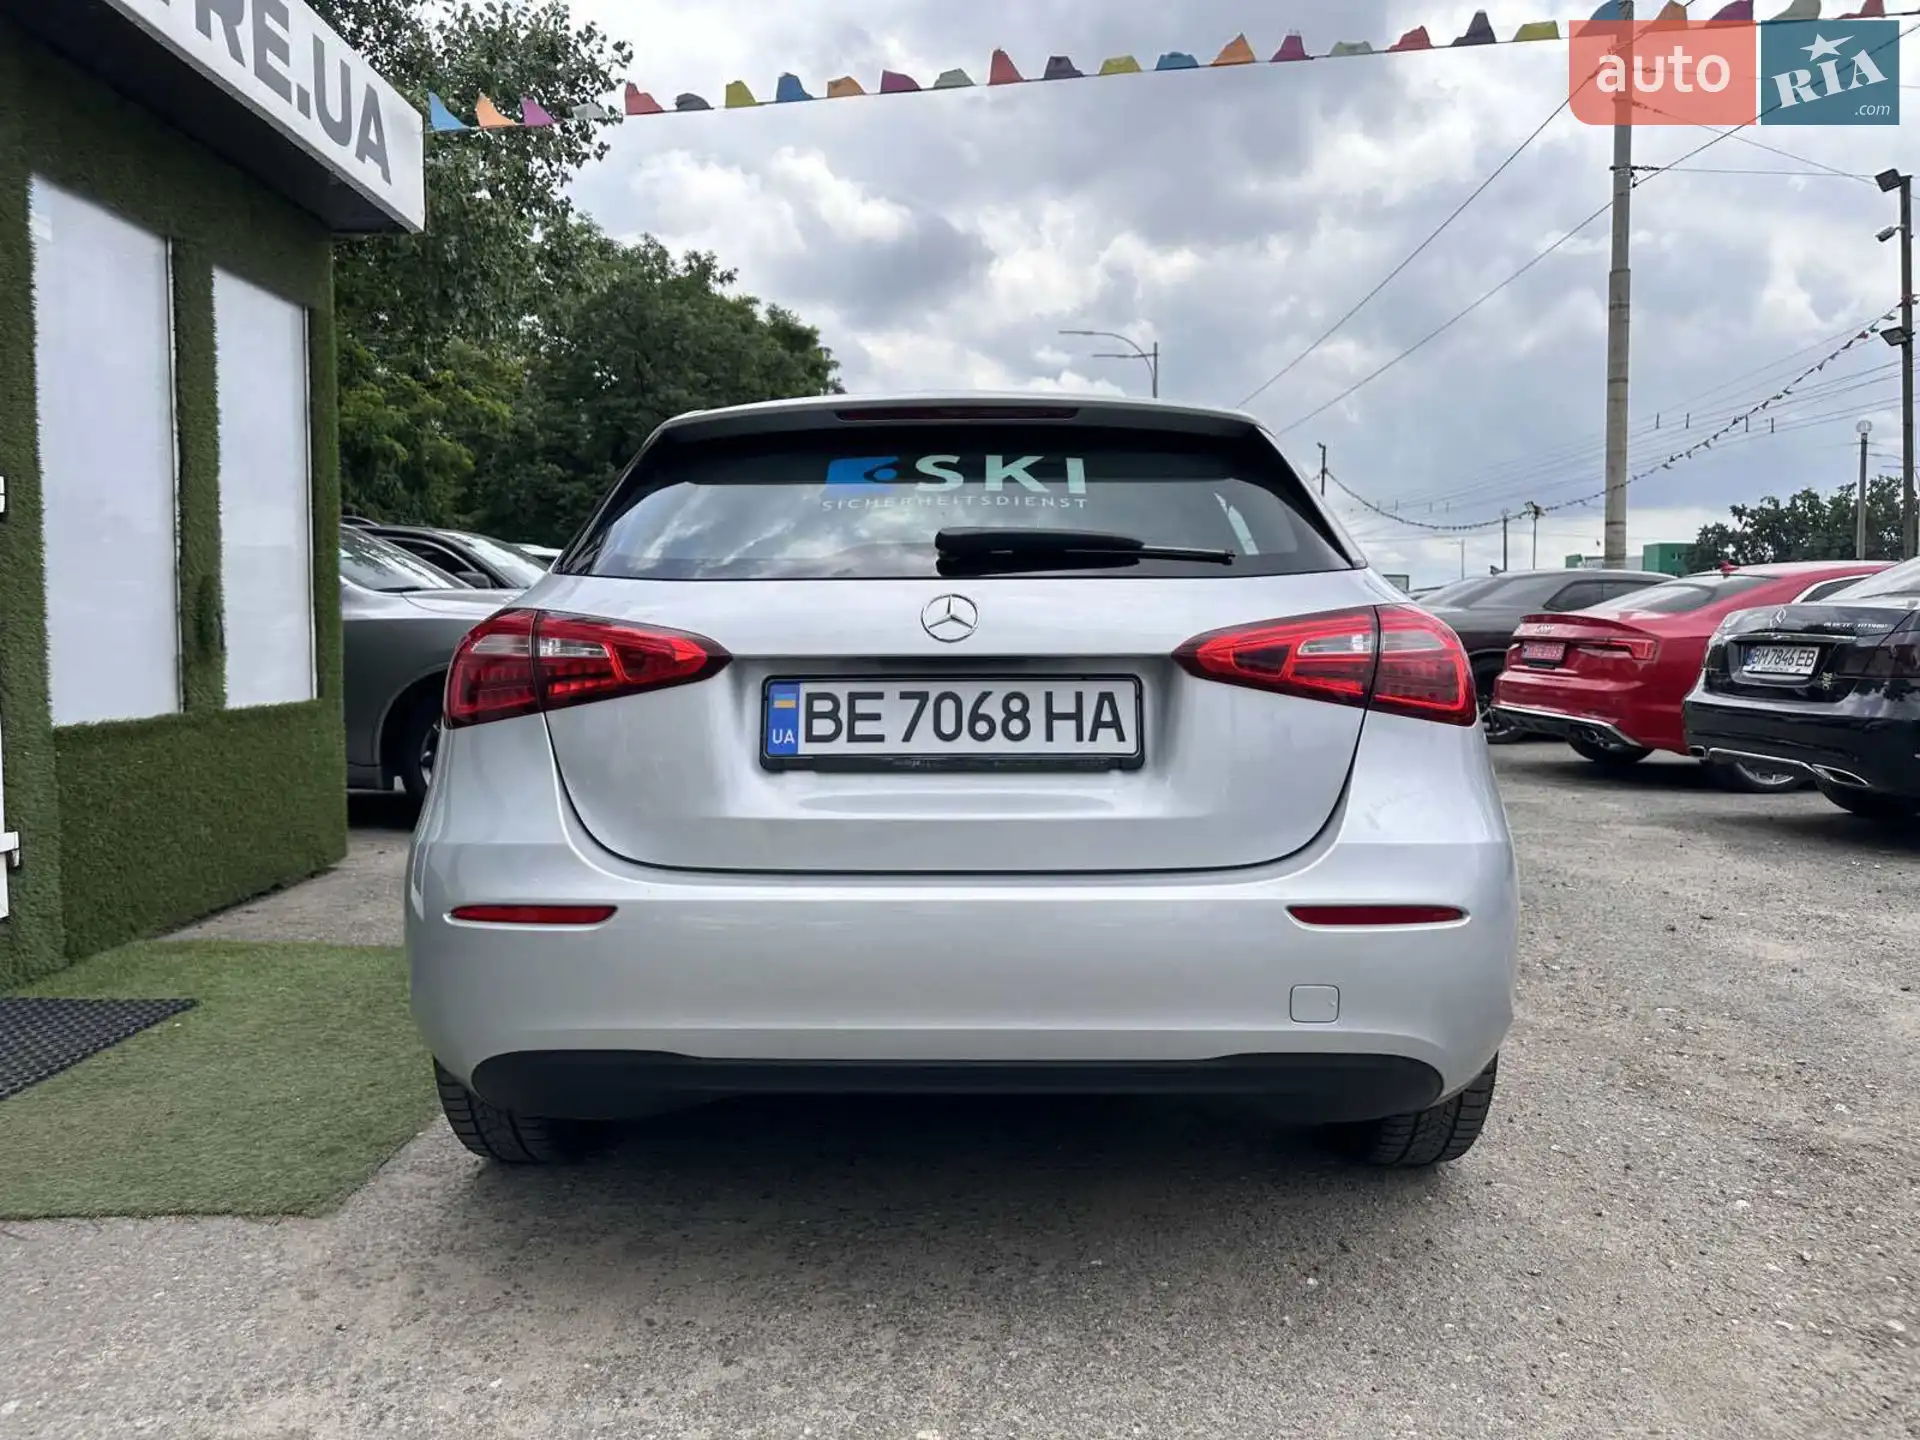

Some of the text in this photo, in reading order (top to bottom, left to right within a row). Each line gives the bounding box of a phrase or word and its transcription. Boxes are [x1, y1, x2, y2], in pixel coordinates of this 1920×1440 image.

[157, 0, 392, 186] RE.UA
[915, 454, 1087, 494] SKI
[822, 496, 1088, 511] SICHERHEITSDIENST
[772, 729, 795, 744] UA
